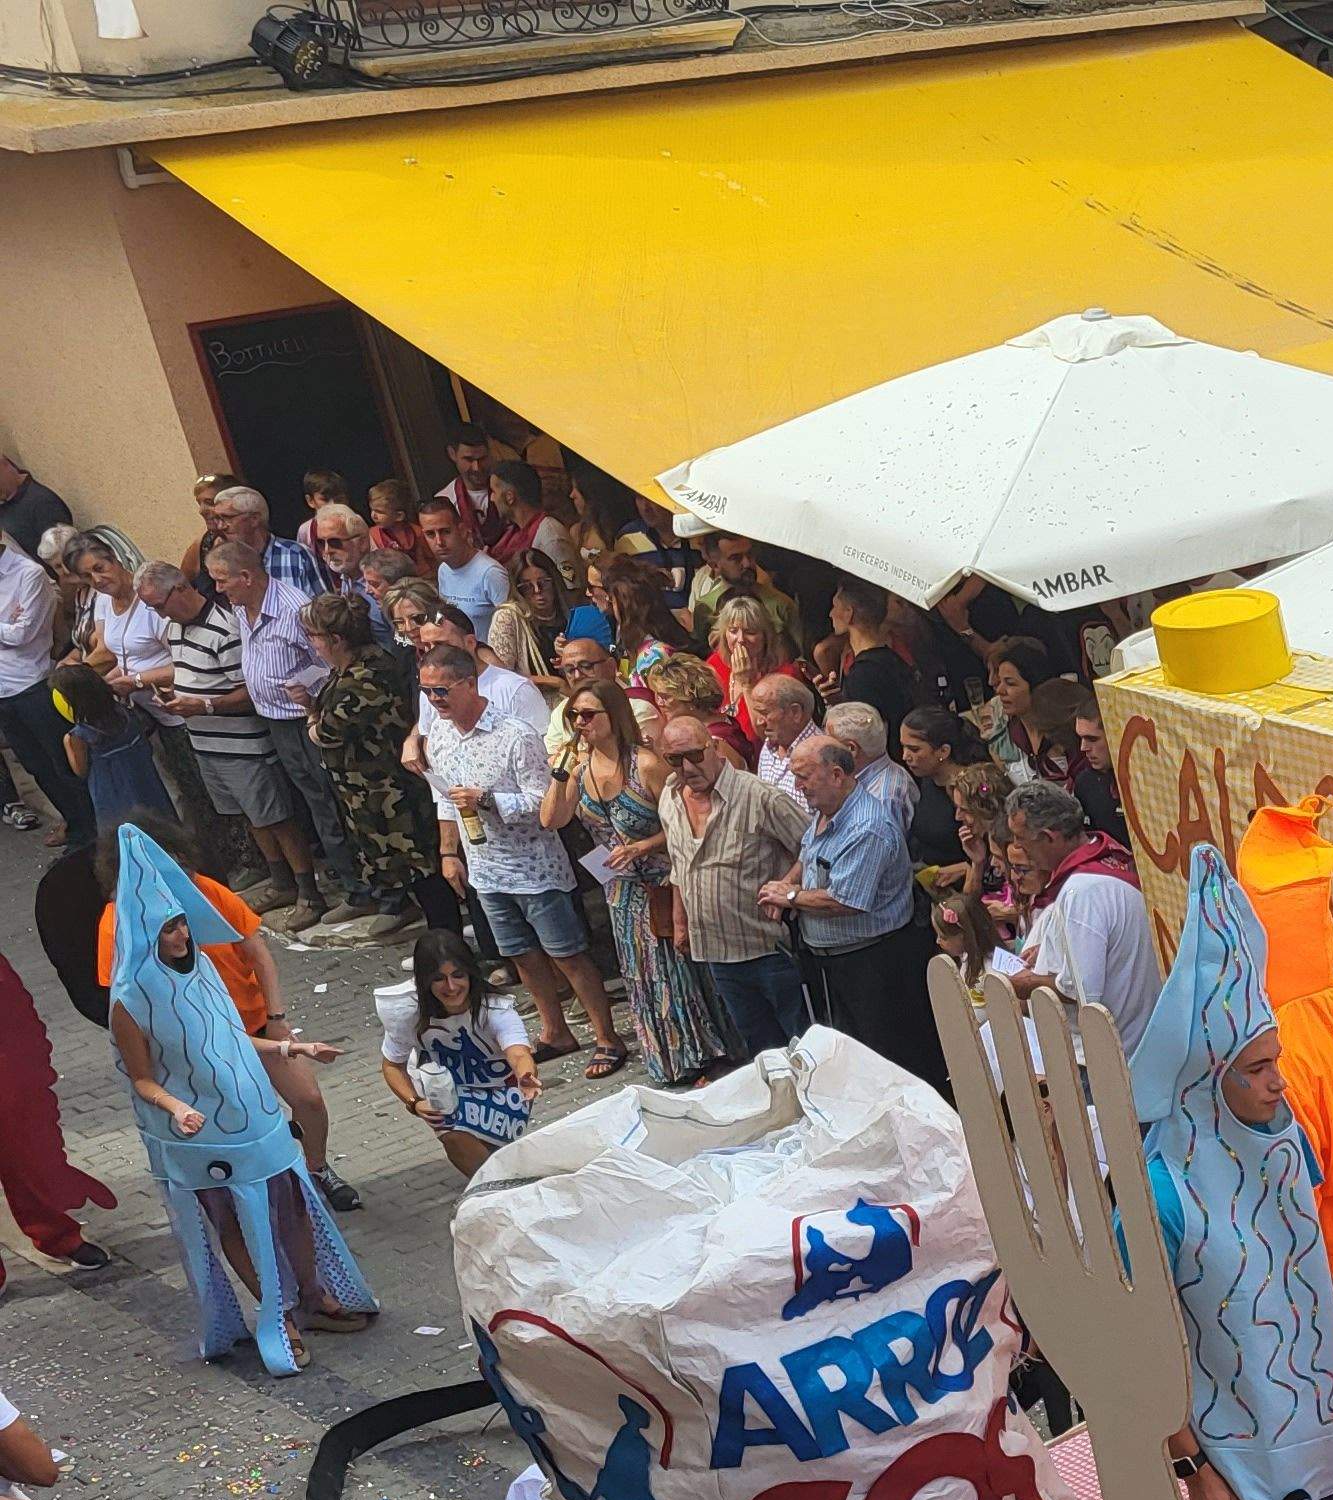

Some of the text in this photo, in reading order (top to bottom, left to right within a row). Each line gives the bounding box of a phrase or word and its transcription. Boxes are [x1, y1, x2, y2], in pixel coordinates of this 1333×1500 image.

[679, 489, 728, 516] AMBAR
[842, 545, 889, 574] CERVECEROS
[464, 1101, 528, 1141] BUENO
